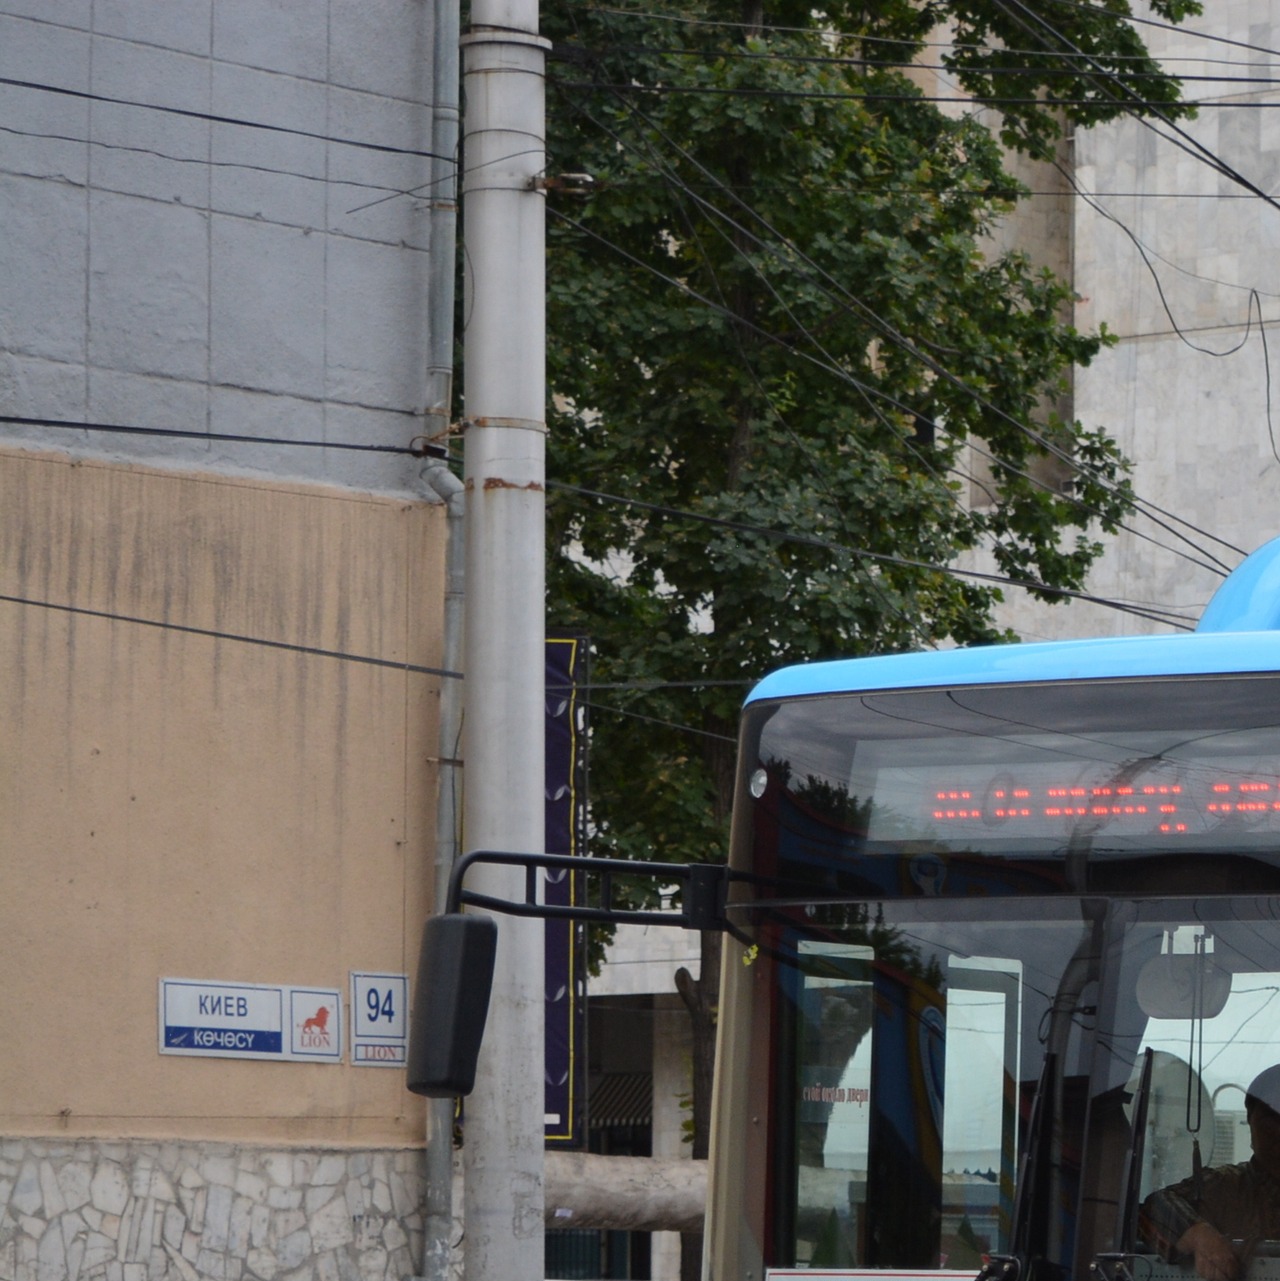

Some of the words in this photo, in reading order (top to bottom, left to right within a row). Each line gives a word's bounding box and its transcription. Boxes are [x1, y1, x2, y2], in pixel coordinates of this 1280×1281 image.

[199, 994, 248, 1017] КИЕВ
[366, 987, 395, 1023] 94
[300, 1034, 331, 1048] LION
[364, 1045, 396, 1060] LION
